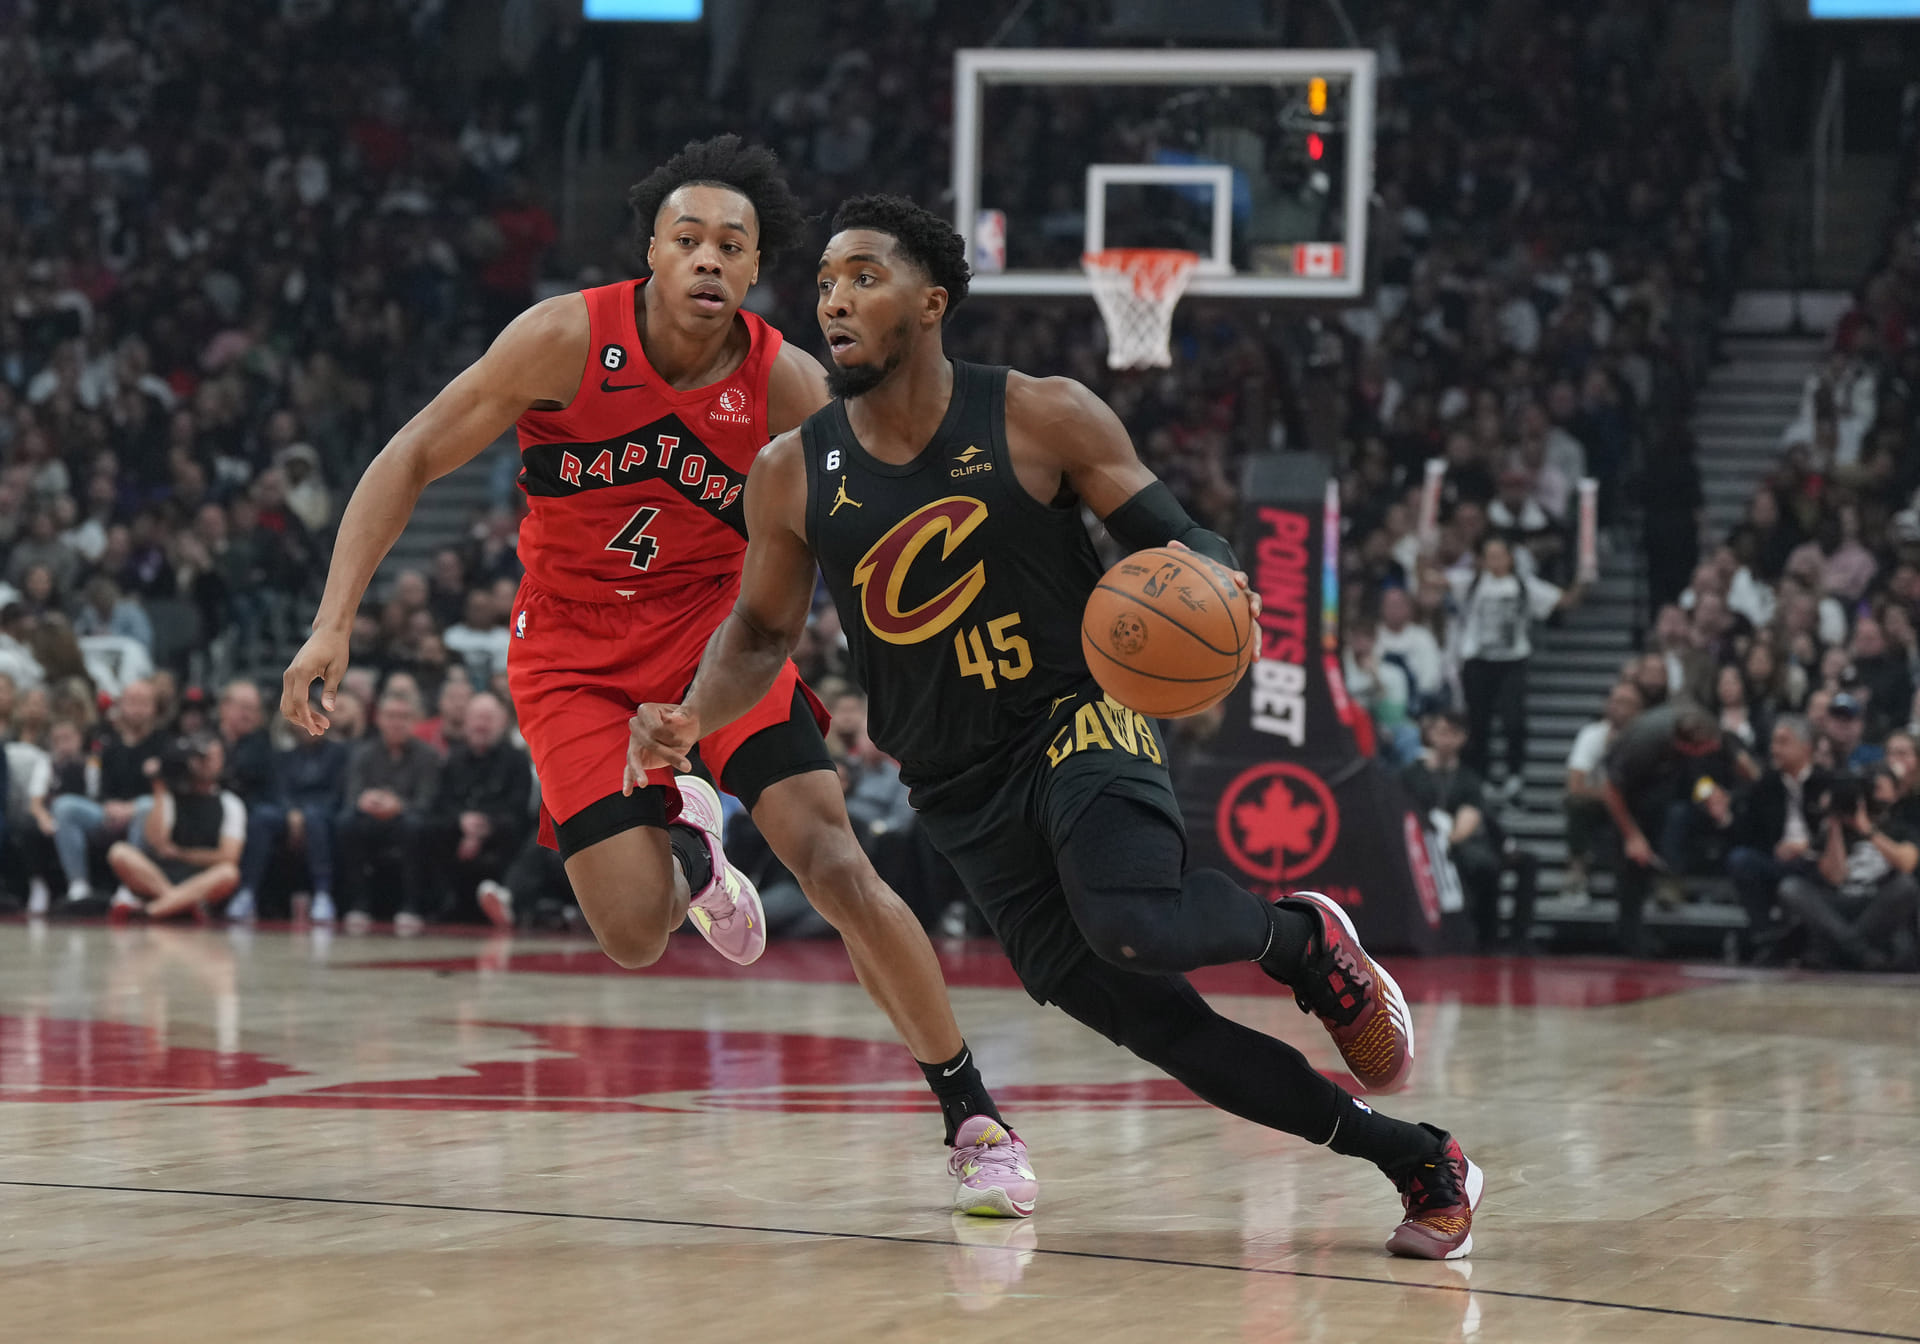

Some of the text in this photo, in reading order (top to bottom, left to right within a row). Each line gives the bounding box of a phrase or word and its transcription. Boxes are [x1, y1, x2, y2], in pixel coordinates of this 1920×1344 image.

[605, 347, 622, 369] 6
[709, 411, 752, 425] Sun Life
[559, 434, 742, 511] RAPTORS
[826, 449, 841, 471] 6
[950, 462, 993, 478] CLIFFS
[604, 506, 661, 571] 4
[852, 495, 989, 646] C
[953, 611, 1034, 690] 45
